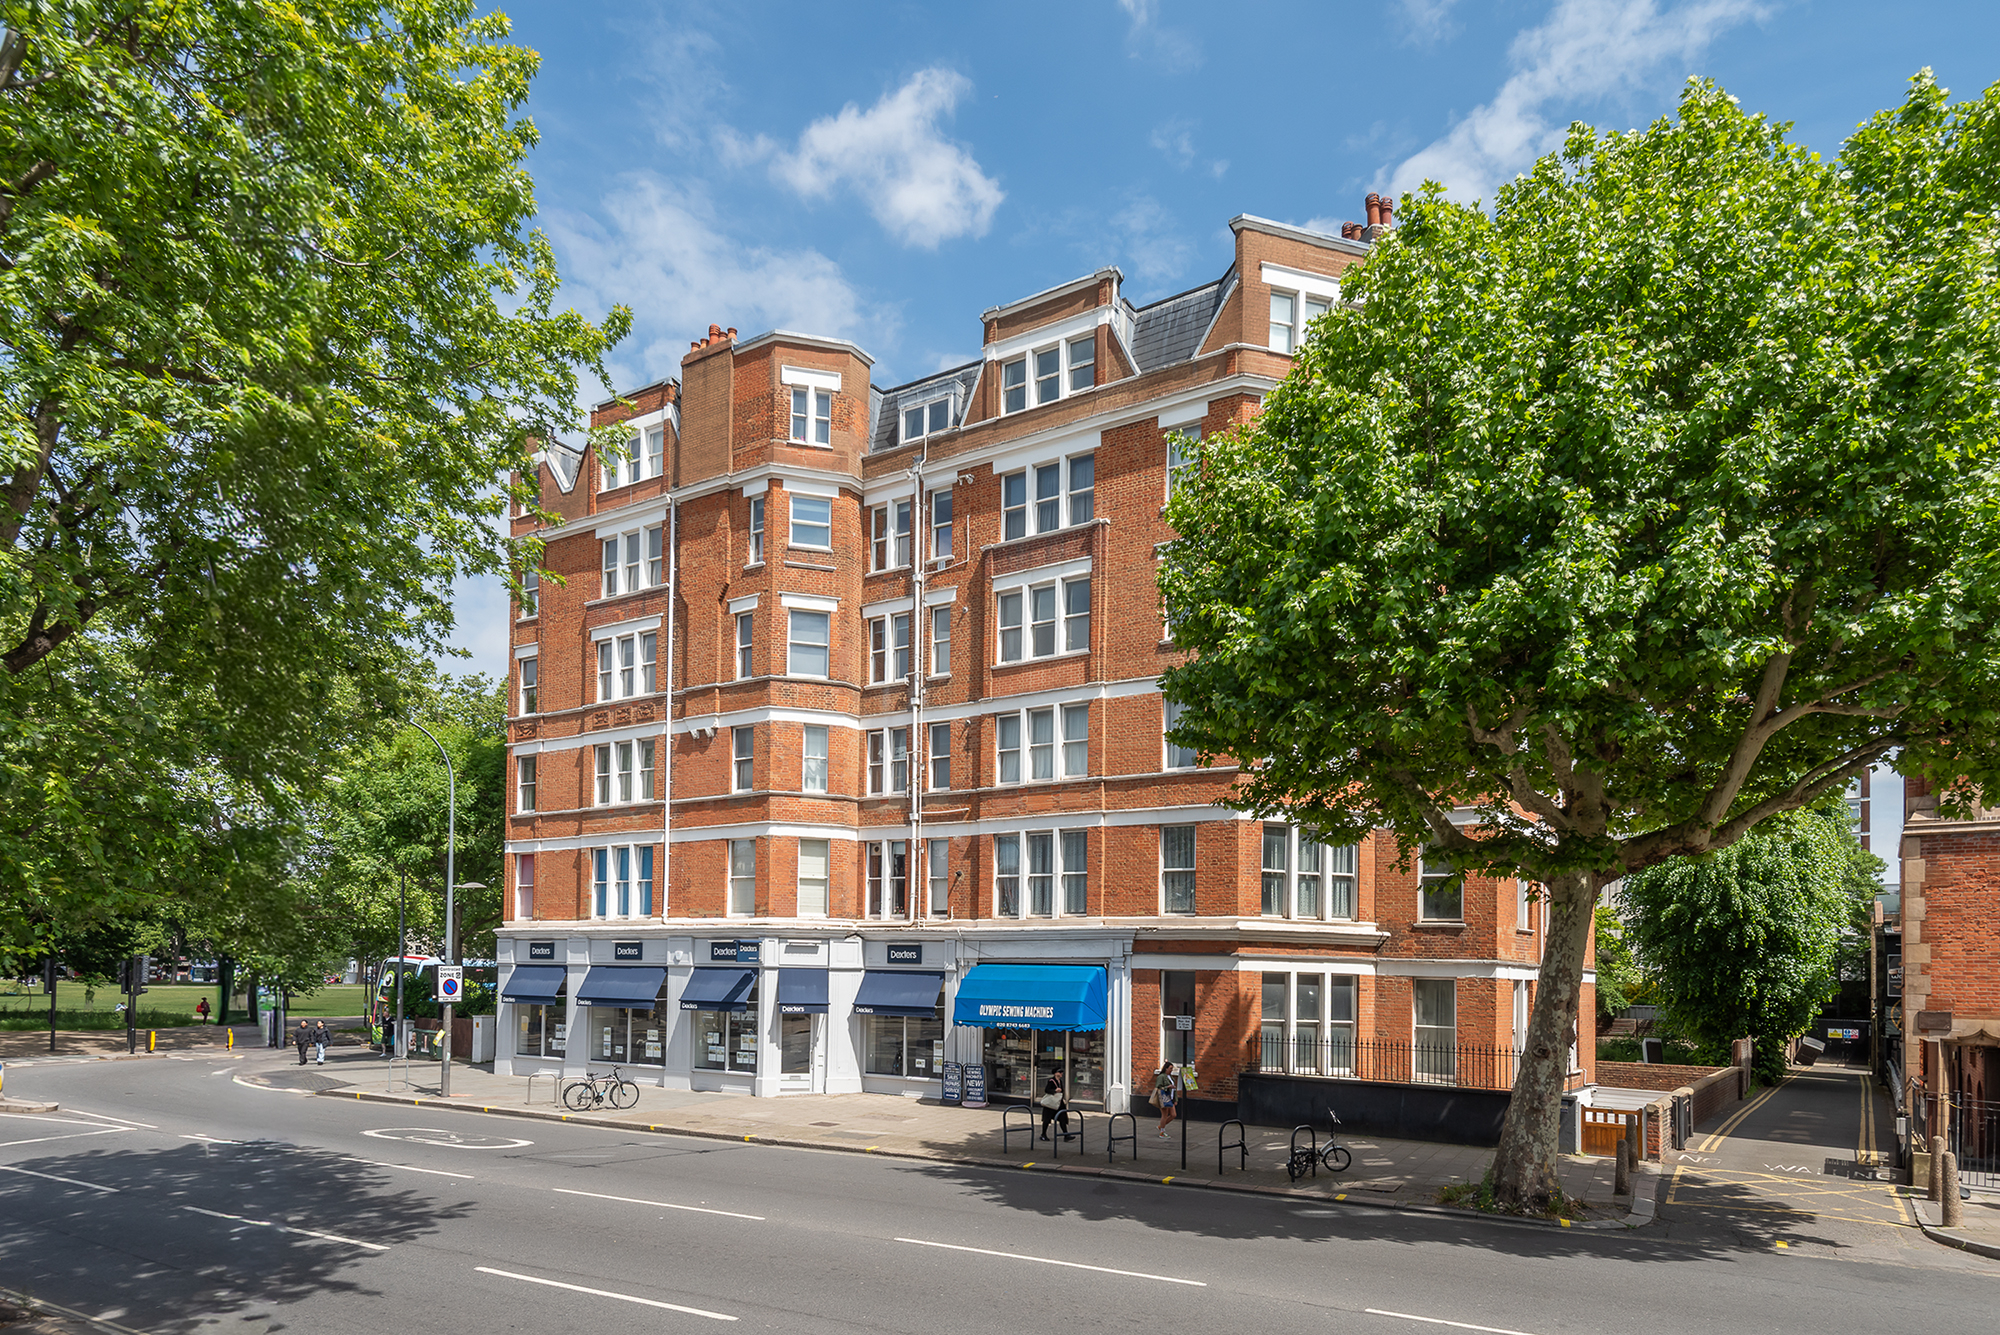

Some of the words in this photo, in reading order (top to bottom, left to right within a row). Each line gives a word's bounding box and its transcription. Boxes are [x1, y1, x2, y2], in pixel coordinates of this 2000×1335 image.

[532, 947, 550, 955] Dexters
[617, 947, 638, 955] Dexters
[714, 947, 737, 956] Dexters
[890, 950, 917, 959] Dexters
[979, 1004, 1002, 1017] OLYMPIC
[1002, 1005, 1024, 1018] SEWING
[1024, 1006, 1054, 1019] MACHINES
